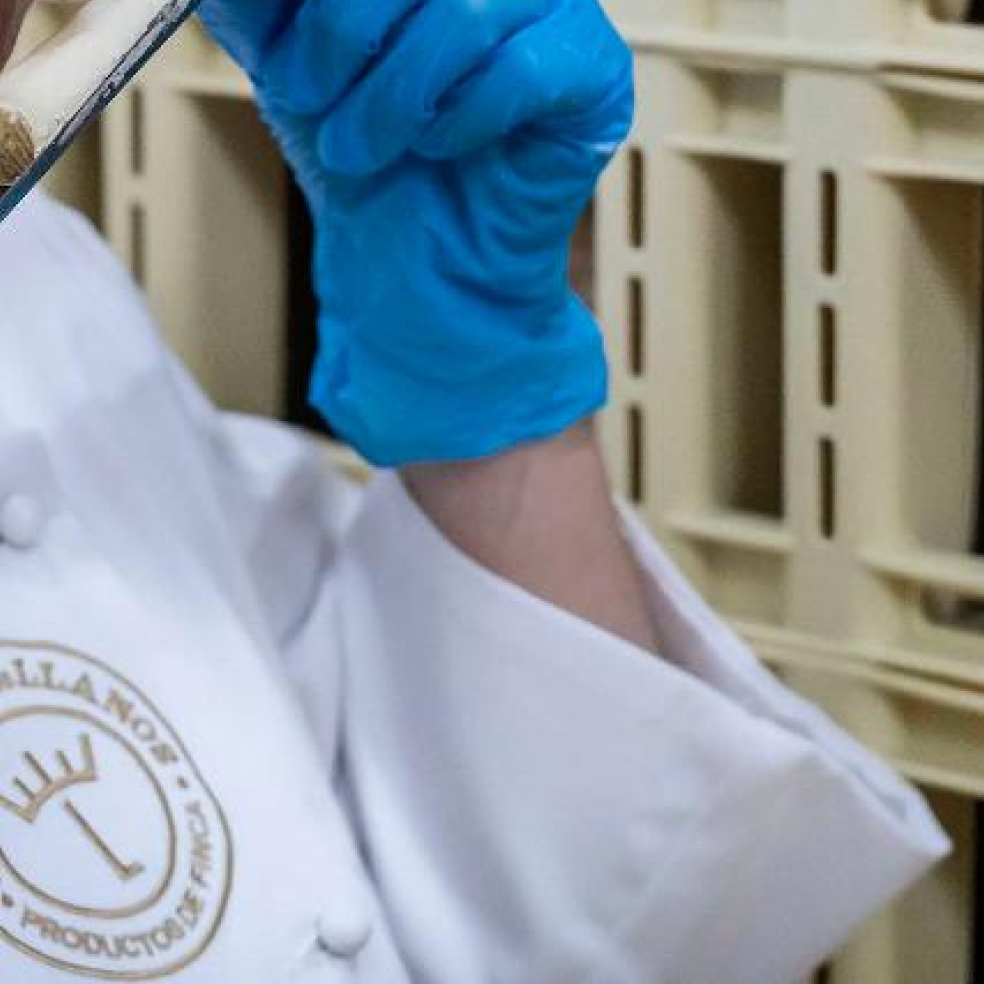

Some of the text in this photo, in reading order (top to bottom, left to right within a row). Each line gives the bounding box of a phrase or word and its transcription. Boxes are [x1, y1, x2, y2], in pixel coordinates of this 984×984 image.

[12, 658, 178, 765] LLANOS
[20, 906, 185, 959] PRODUCTOS
[184, 800, 213, 889] FINCA
